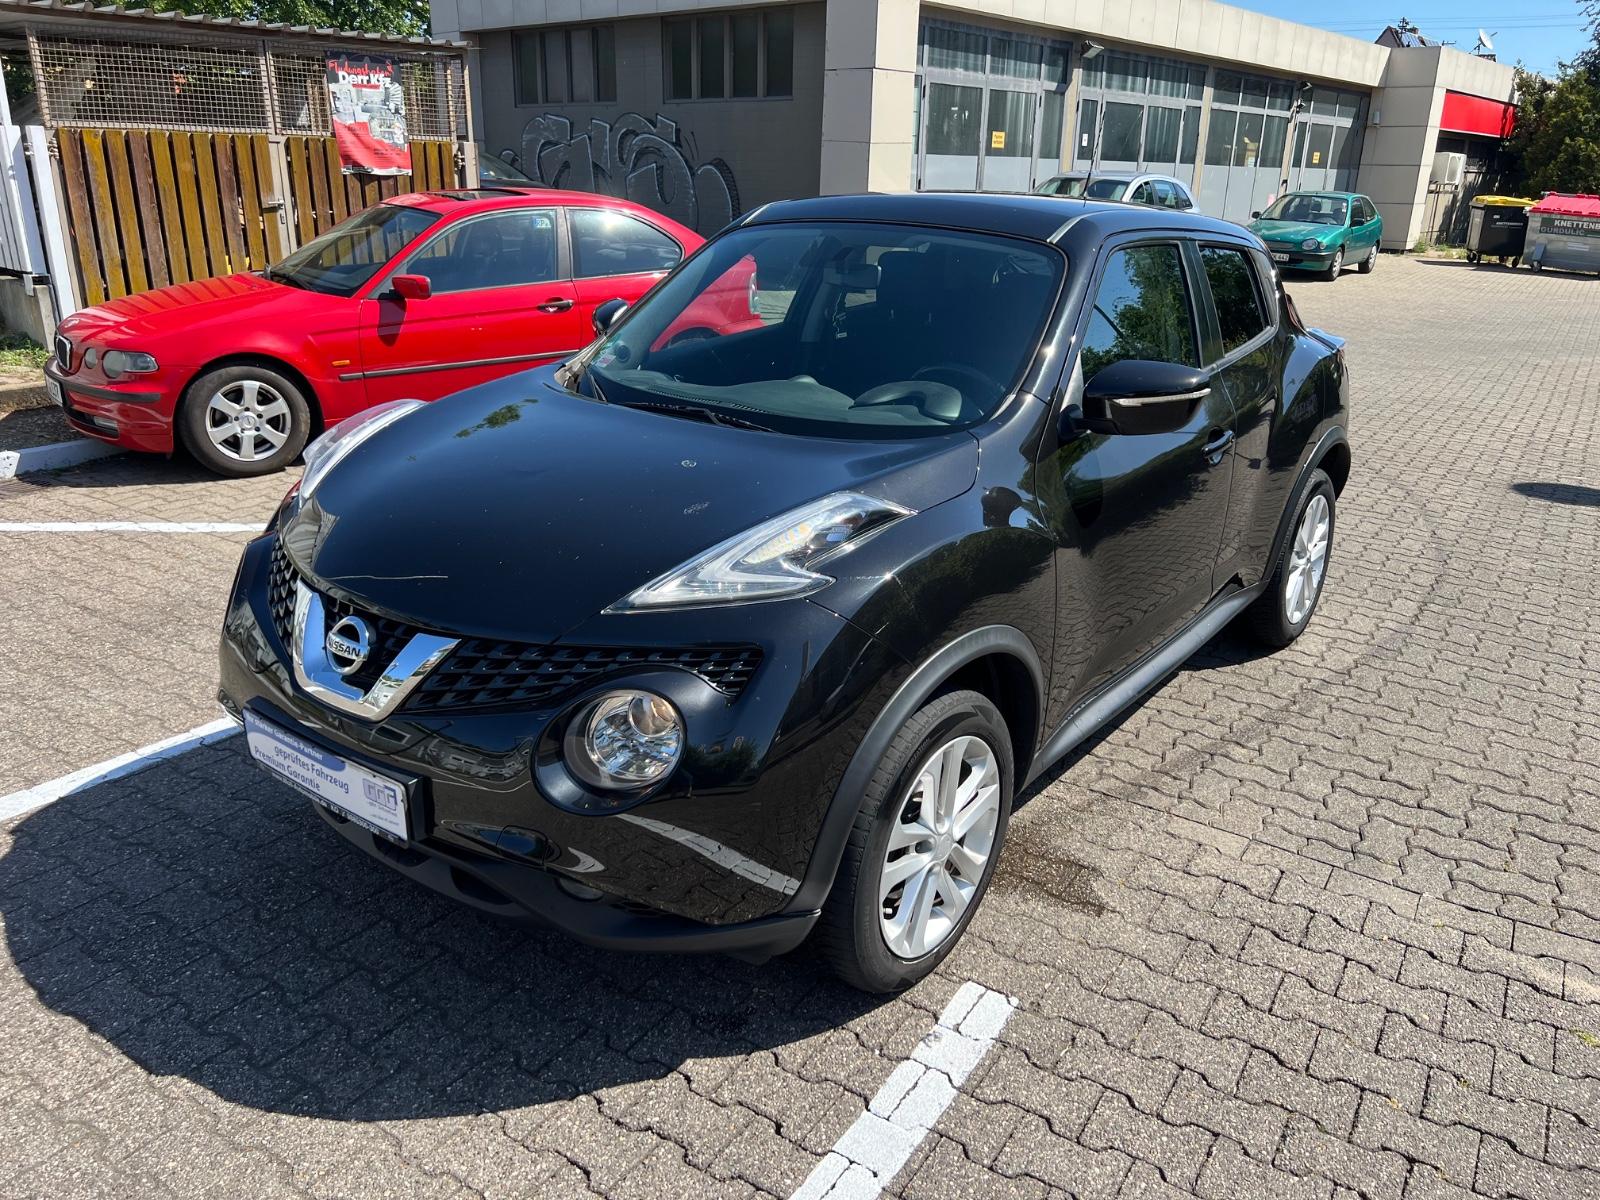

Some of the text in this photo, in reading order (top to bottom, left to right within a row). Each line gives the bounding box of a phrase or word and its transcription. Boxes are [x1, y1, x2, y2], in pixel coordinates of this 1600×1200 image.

[338, 70, 369, 84] Derr
[328, 636, 361, 657] NISSAN
[254, 745, 286, 772] Premium
[287, 764, 321, 792] Garantie
[274, 745, 310, 772] geprüftes
[310, 763, 350, 795] Fahrzeug
